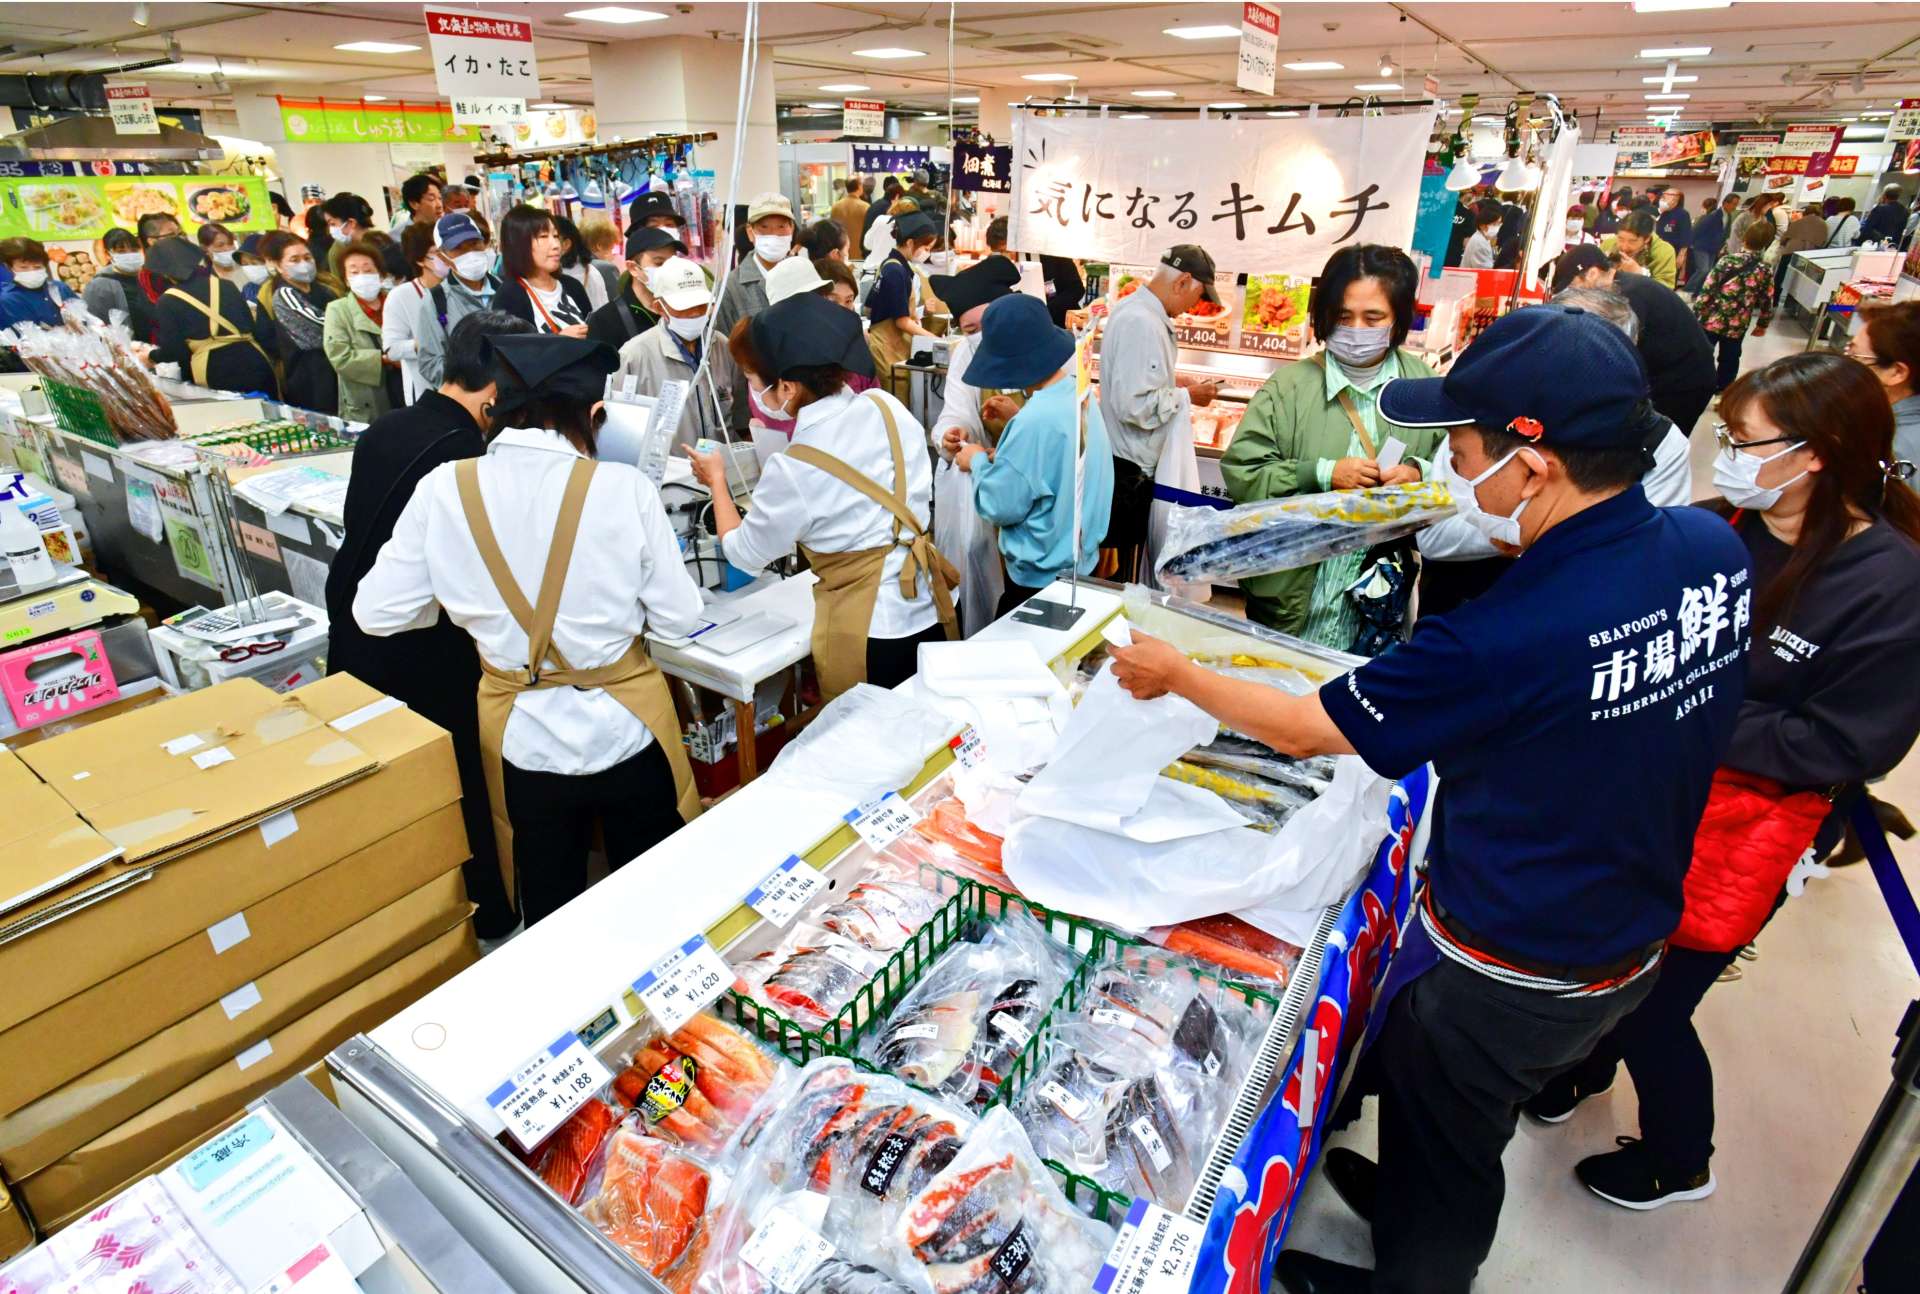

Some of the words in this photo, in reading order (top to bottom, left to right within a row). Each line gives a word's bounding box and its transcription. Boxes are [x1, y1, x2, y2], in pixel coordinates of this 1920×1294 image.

[445, 54, 530, 76] イカ・たこ
[353, 117, 422, 138] しゅうまい
[1029, 181, 1390, 244] 気になるキムチ
[1588, 608, 1668, 648] SEAFOOD'S
[1730, 568, 1748, 588] SHOP
[1769, 625, 1820, 659] MICKEY
[1591, 679, 1684, 721] FISHERMAN'S
[685, 972, 719, 1001] ¥1,620
[549, 1073, 592, 1109] ¥1,188
[1160, 1233, 1189, 1276] ¥2,376
